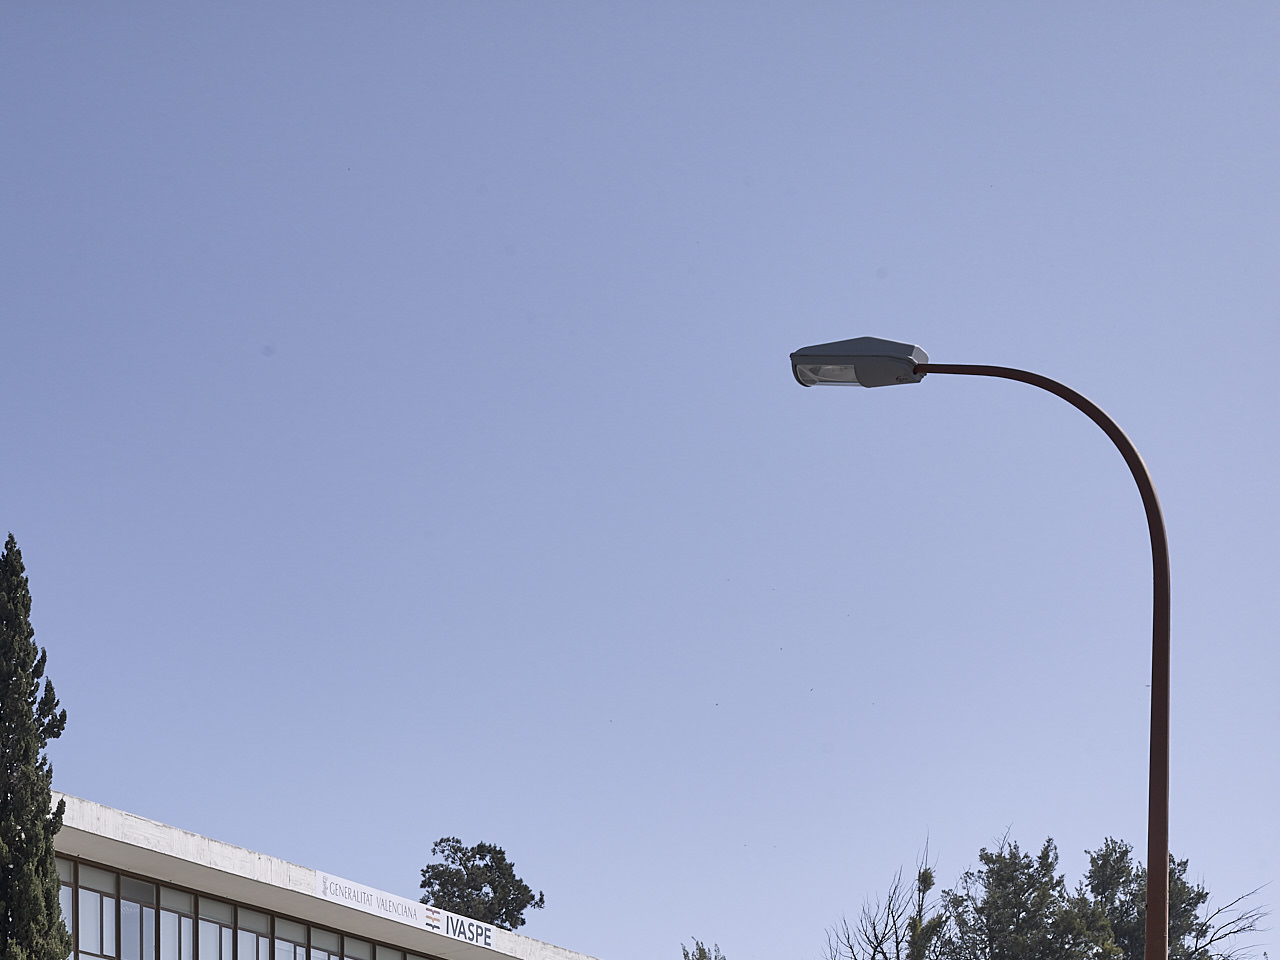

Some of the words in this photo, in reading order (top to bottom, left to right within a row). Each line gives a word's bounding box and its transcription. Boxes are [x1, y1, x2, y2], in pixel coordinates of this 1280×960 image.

[329, 881, 373, 906] GENERALITAT
[376, 896, 418, 920] VALENCIANA
[446, 915, 491, 946] IVASPE
